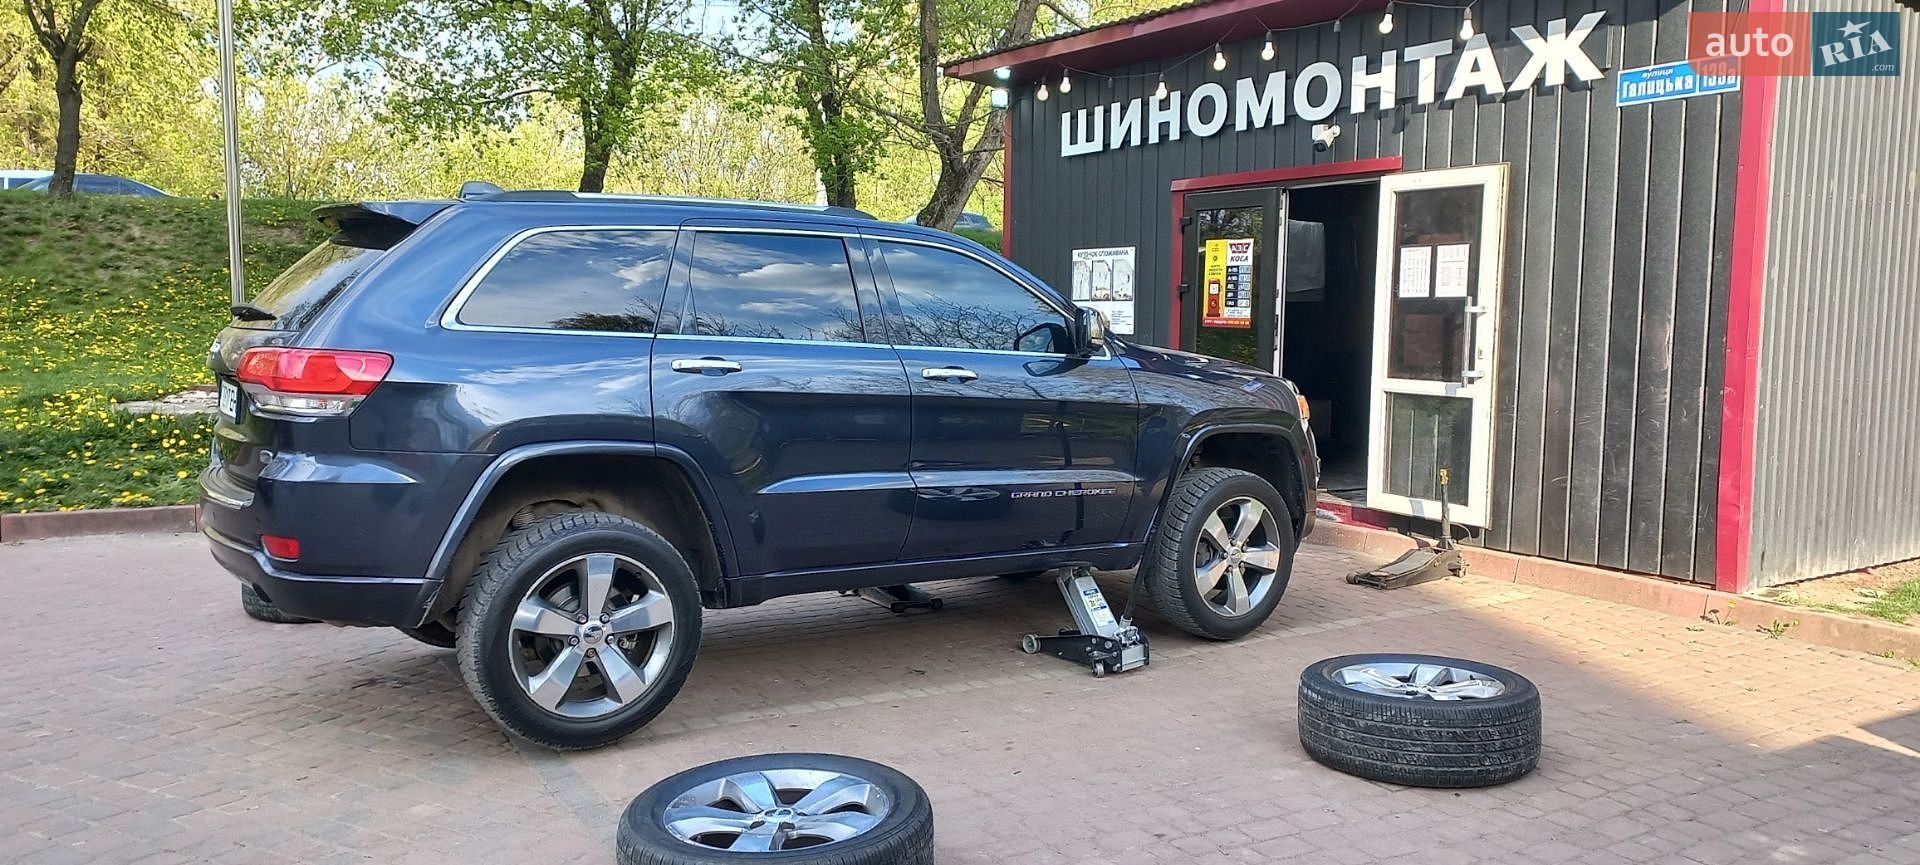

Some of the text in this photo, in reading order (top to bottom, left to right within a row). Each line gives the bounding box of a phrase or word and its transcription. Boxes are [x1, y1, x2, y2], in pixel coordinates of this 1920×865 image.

[1060, 10, 1607, 158] ШИНОМОНТАЖ
[1621, 74, 1694, 99] Галицька
[1011, 490, 1053, 499] GRAND
